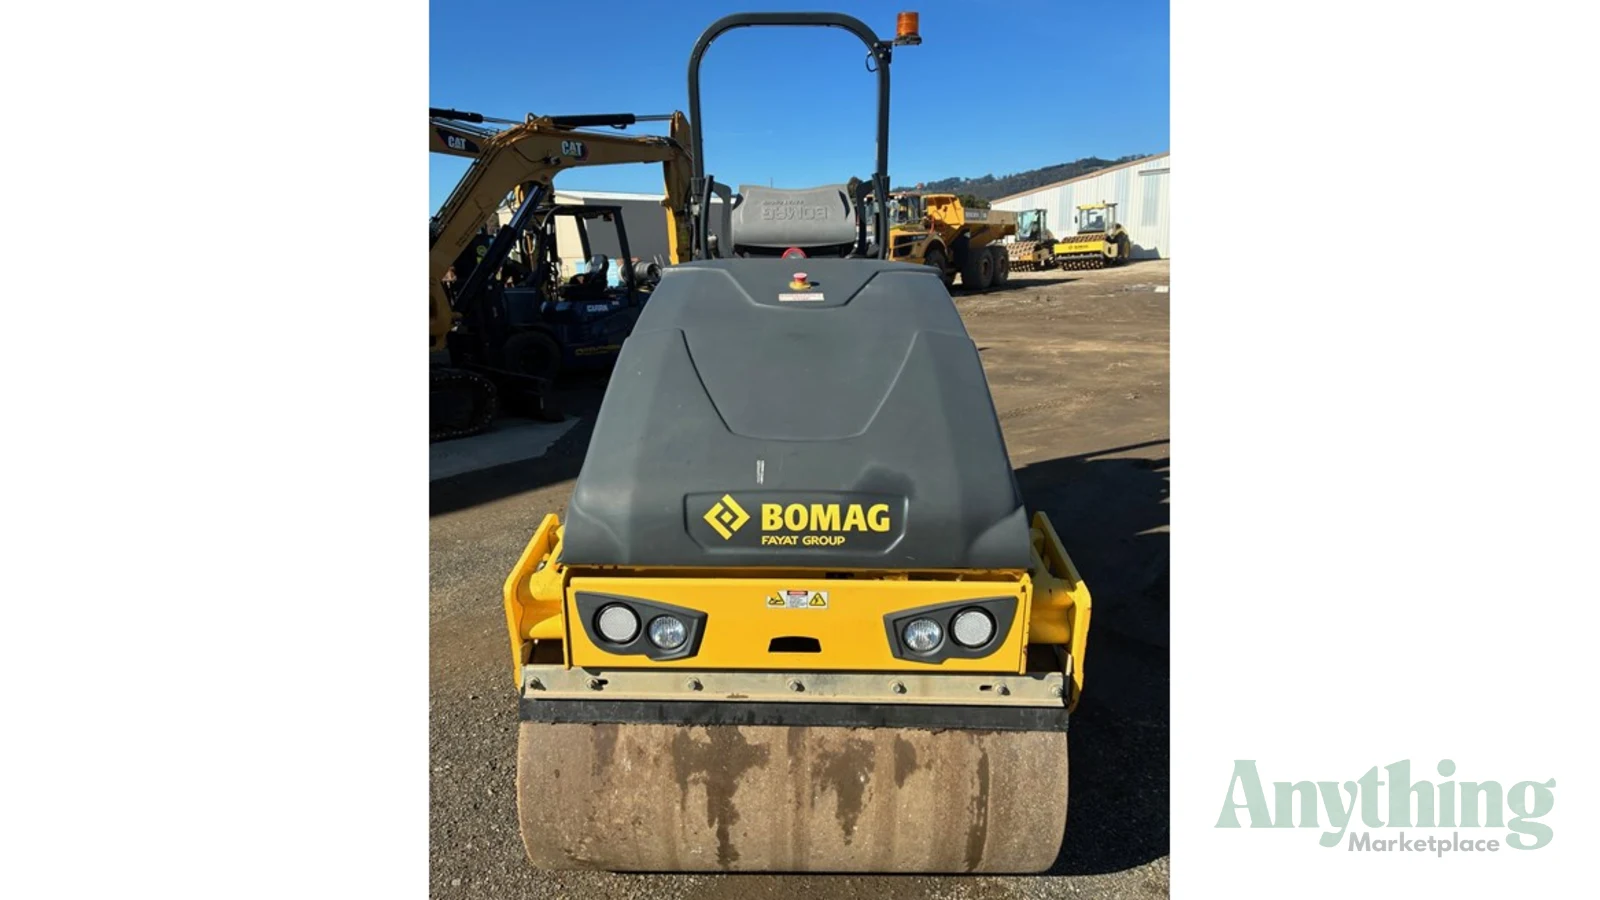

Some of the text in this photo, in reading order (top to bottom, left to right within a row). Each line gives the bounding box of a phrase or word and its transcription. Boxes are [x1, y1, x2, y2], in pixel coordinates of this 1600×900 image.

[448, 135, 467, 149] CAT
[561, 140, 582, 156] CAT
[761, 503, 890, 532] BOMAG
[761, 535, 846, 546] FAYAT GROUP
